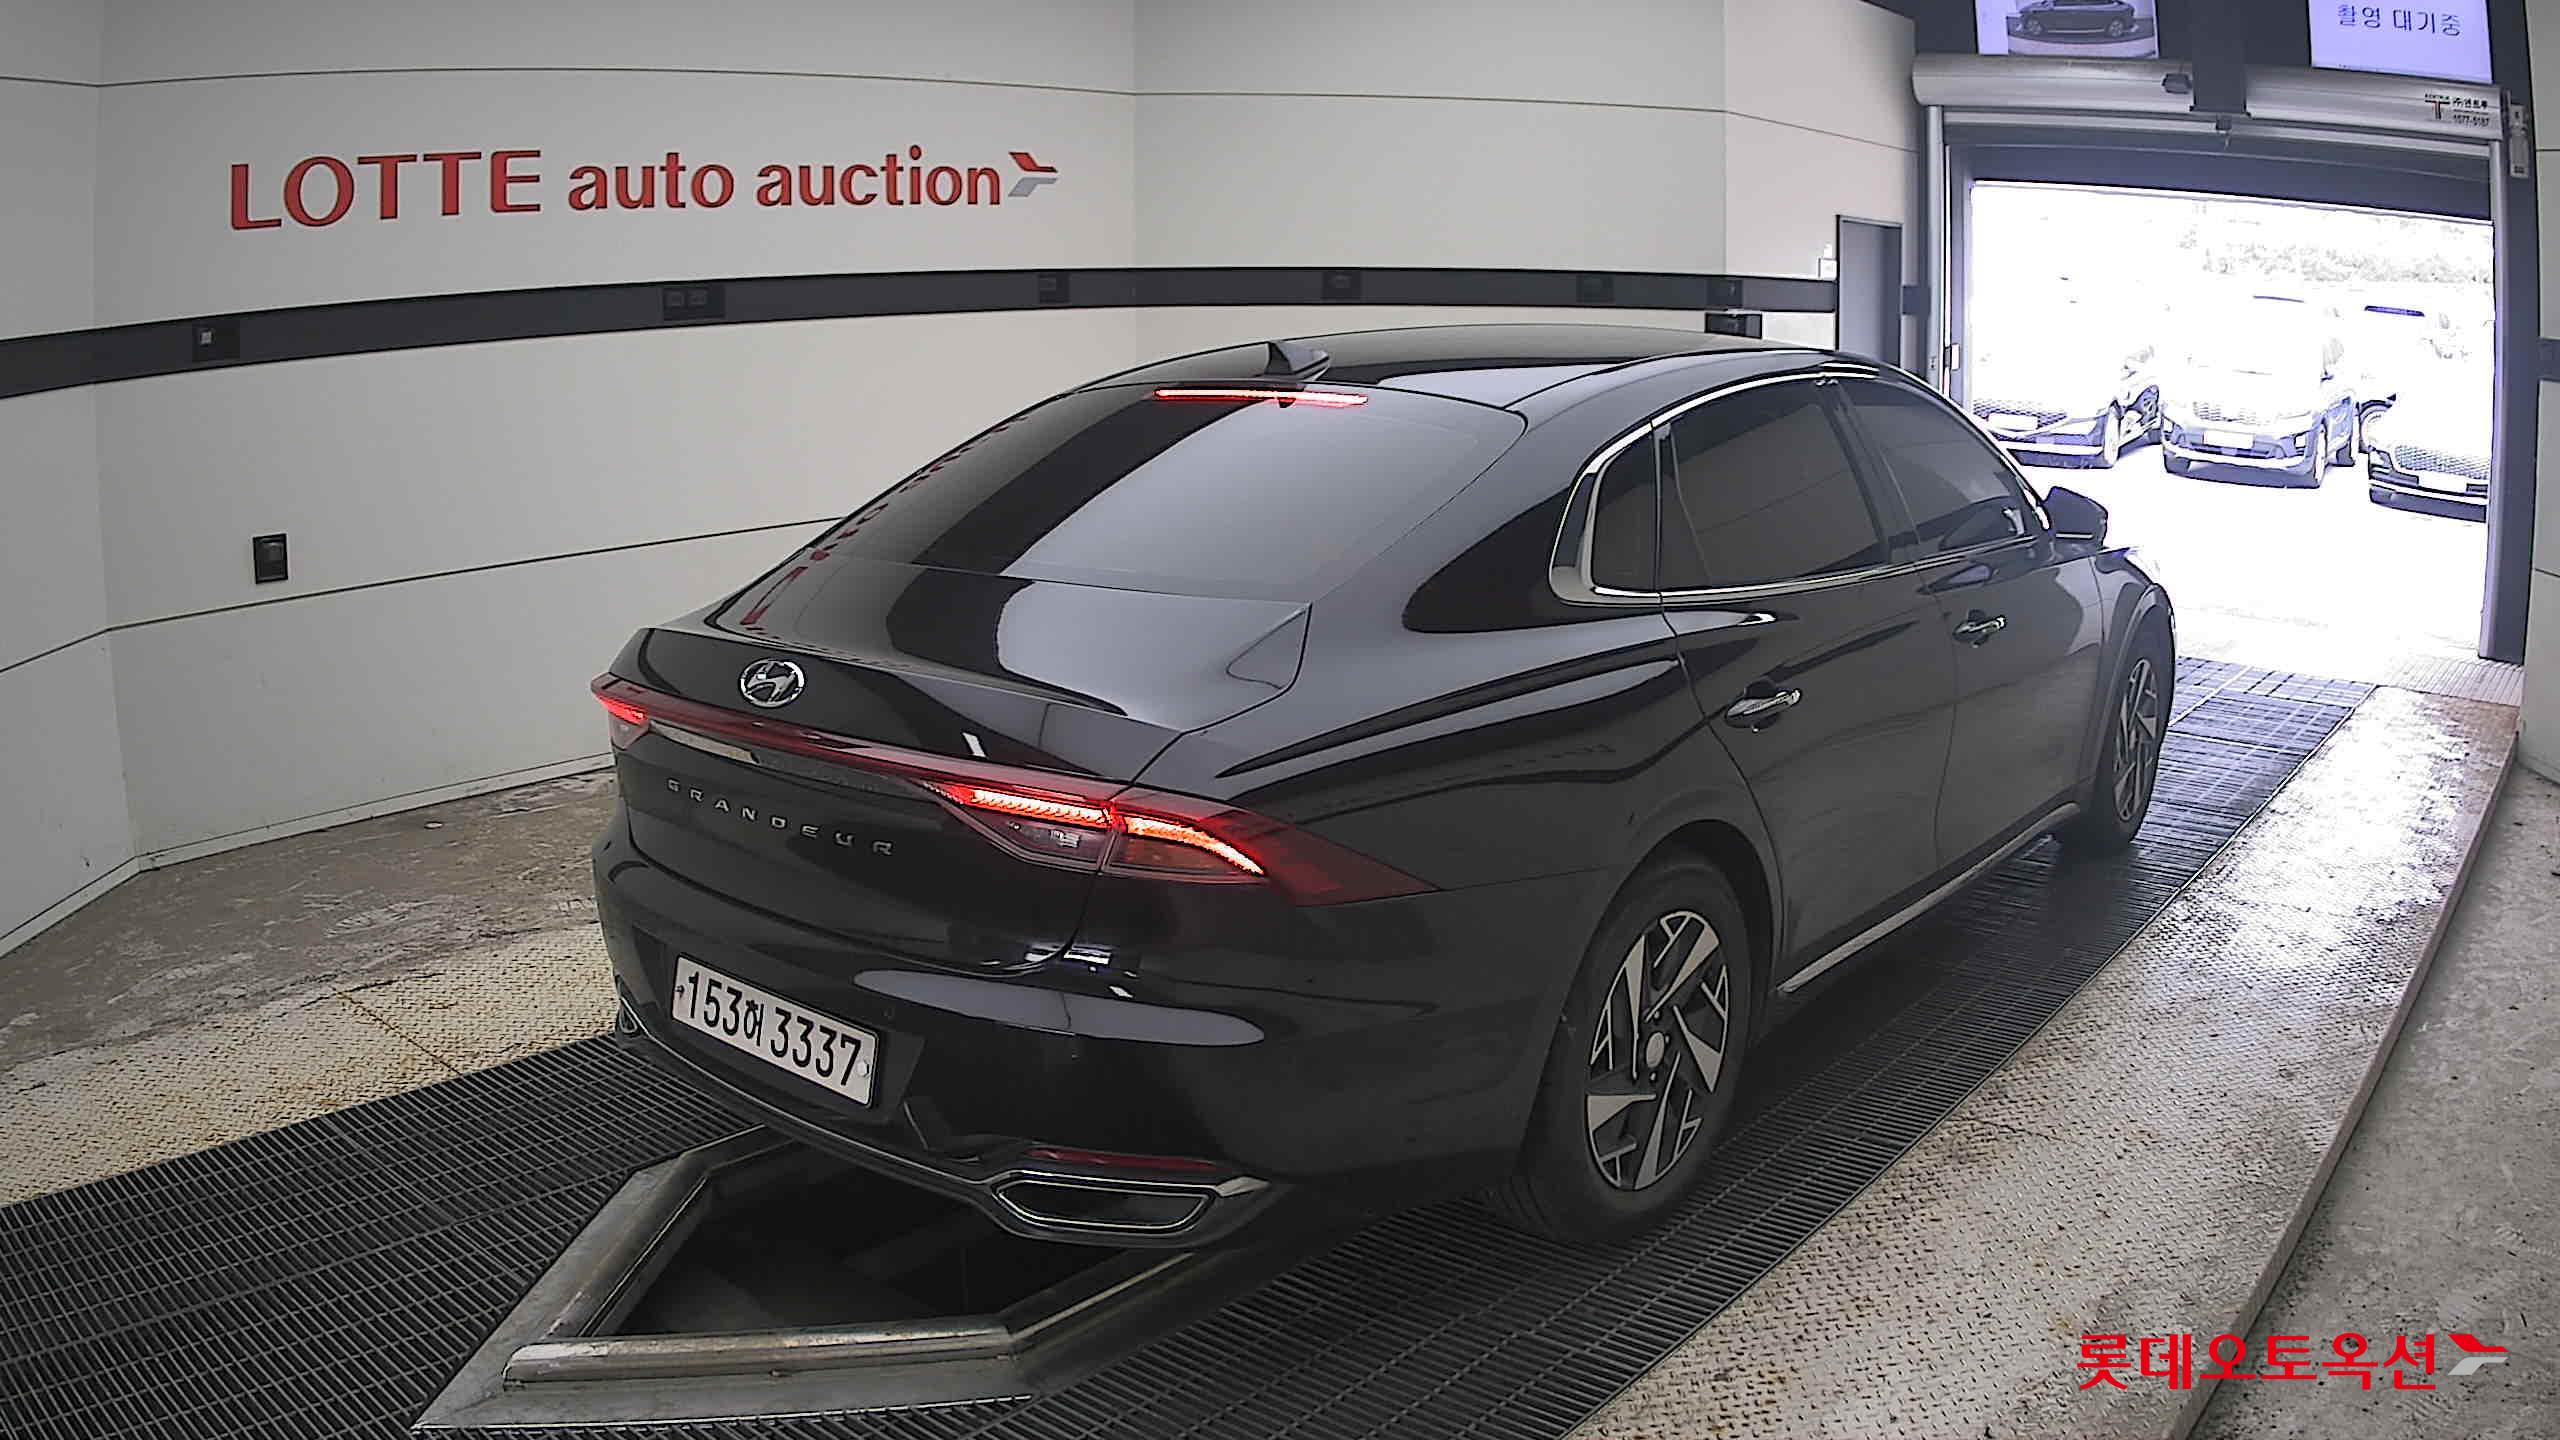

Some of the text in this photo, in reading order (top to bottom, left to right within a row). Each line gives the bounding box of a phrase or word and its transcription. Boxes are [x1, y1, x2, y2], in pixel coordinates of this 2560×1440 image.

[2393, 9, 2461, 36] 대기중
[231, 145, 1001, 230] LOTTE auto auction
[667, 778, 894, 856] GRANDEUR
